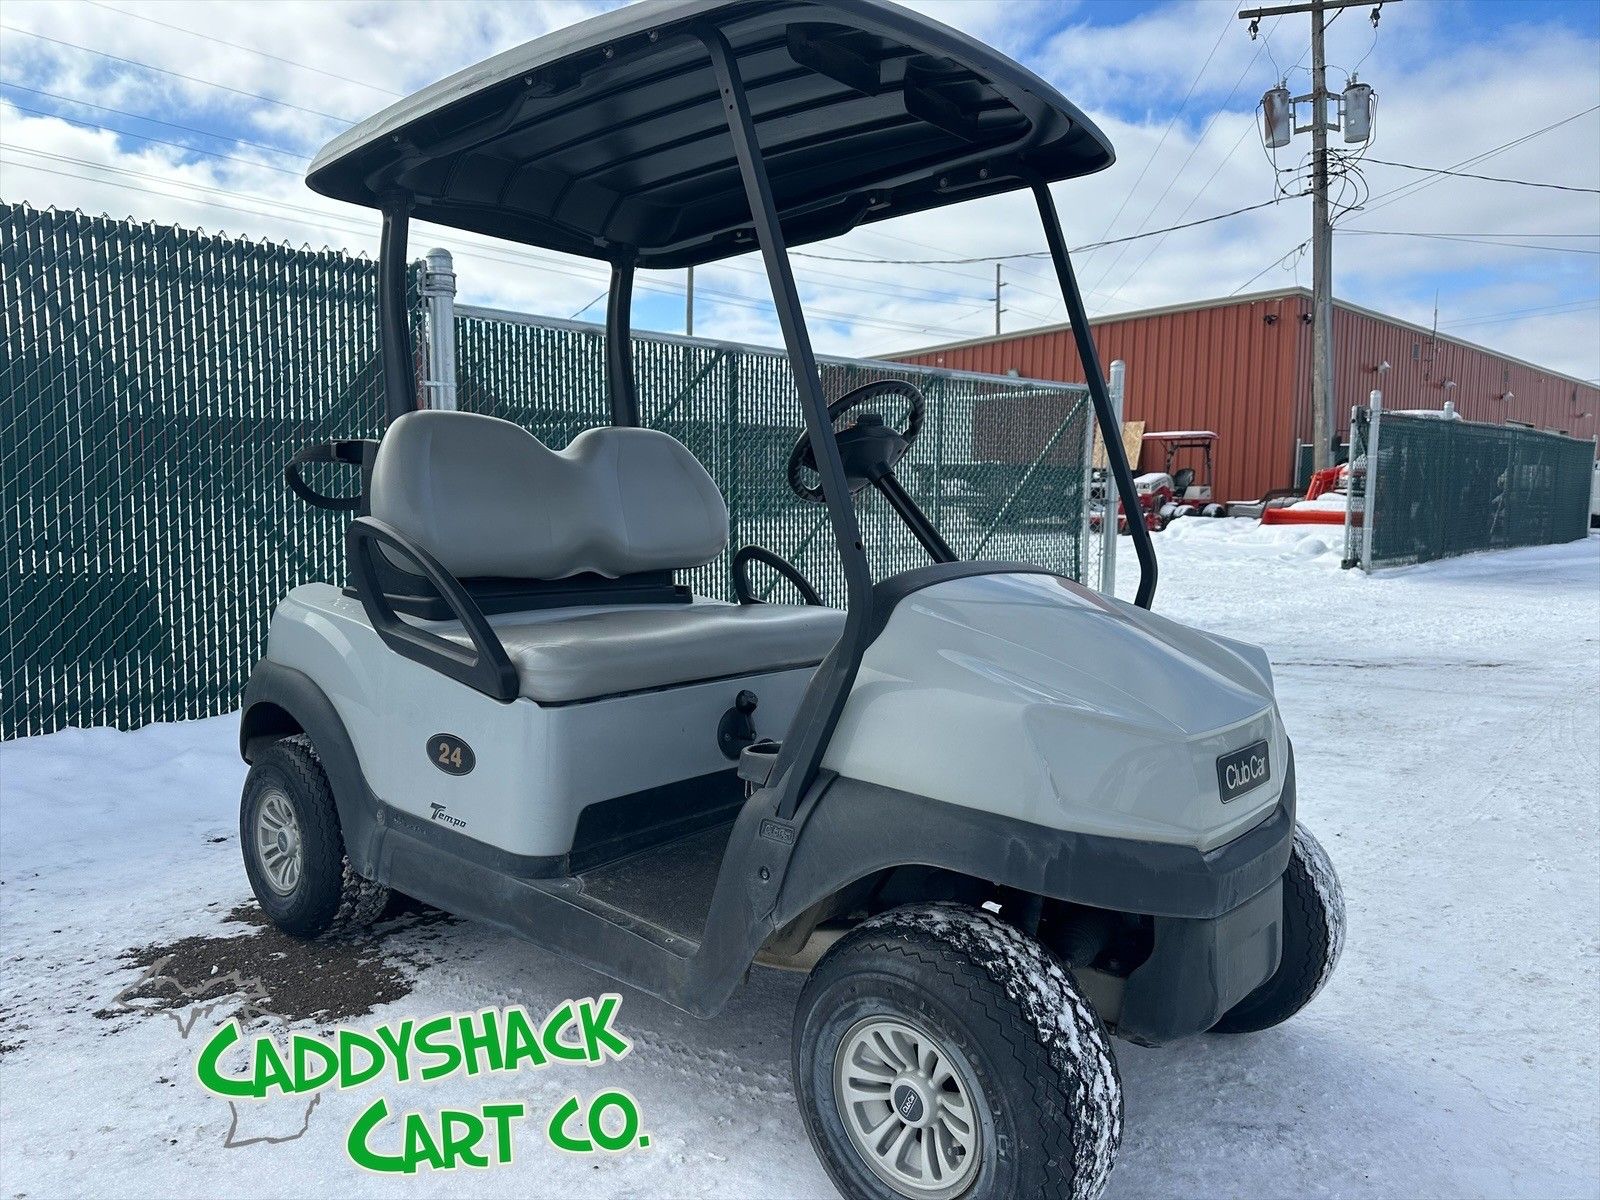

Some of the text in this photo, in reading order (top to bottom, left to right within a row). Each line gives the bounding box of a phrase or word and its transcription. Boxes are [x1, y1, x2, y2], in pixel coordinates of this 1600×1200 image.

[438, 742, 463, 768] 24
[1226, 755, 1265, 789] Club Car
[430, 802, 467, 828] Tempo
